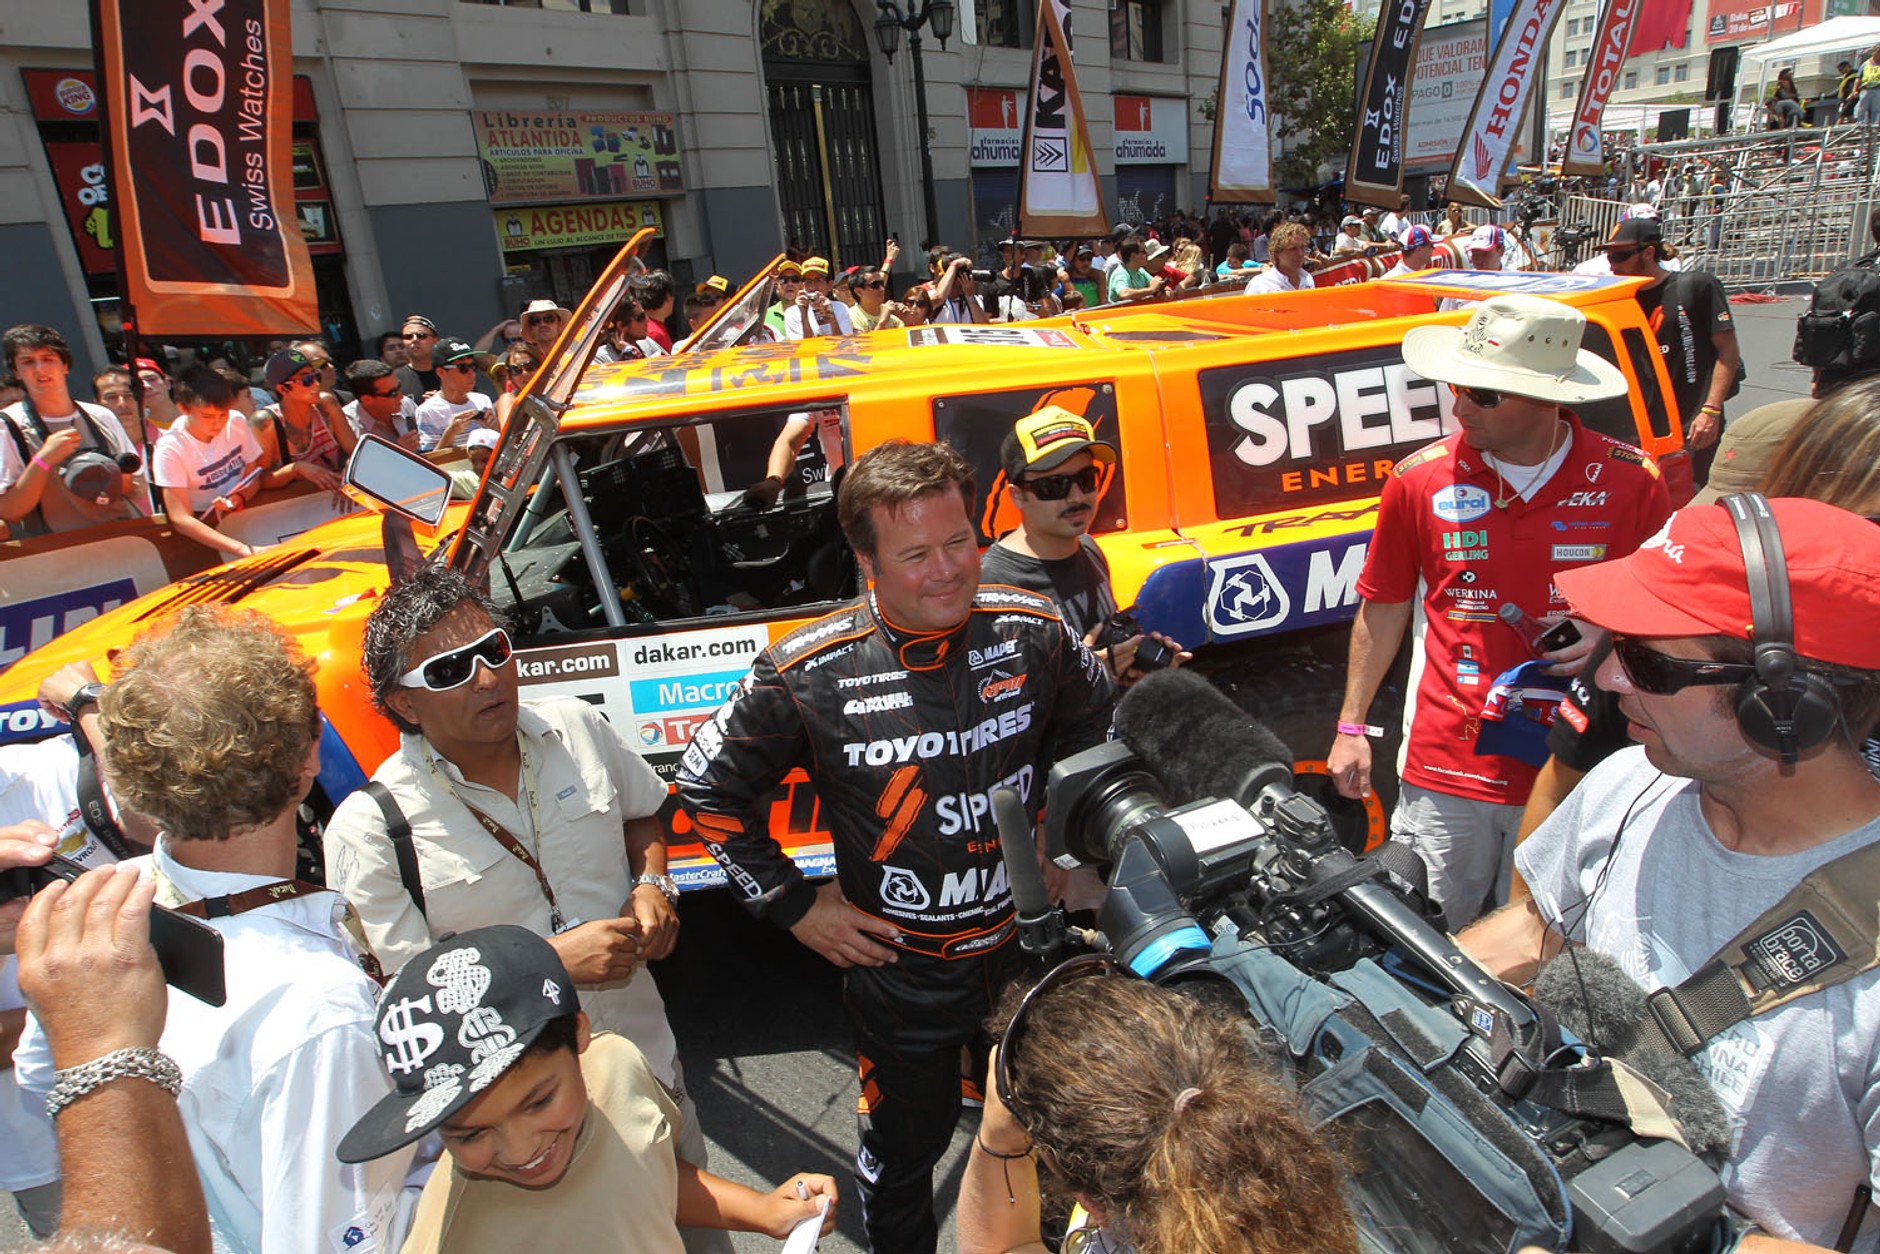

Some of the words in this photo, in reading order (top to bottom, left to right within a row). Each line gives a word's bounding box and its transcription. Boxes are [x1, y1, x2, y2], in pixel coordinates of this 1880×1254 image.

[1415, 60, 1464, 80] OTENCIAL
[1485, 0, 1550, 139] HONDA
[1584, 0, 1632, 117] TOTAL
[238, 19, 265, 141] Watches
[63, 91, 91, 107] KING
[182, 0, 242, 245] EDOX
[1375, 72, 1397, 169] EDOX
[488, 130, 583, 147] ATLANTIDA
[1115, 141, 1166, 158] ahumada
[241, 152, 273, 231] Swiss
[531, 206, 637, 236] AGENDAS
[1438, 495, 1486, 510] eurol
[1443, 530, 1488, 548] HDI
[1445, 549, 1488, 561] GERLING
[1444, 588, 1498, 600] WERKINA
[634, 639, 757, 665] dakar.com
[843, 731, 944, 767] TOYO
[946, 703, 1032, 757] TIRES
[706, 843, 764, 901] SPEED
[920, 913, 956, 923] SEALANTS
[1763, 938, 1804, 979] brace
[1781, 928, 1821, 971] porta
